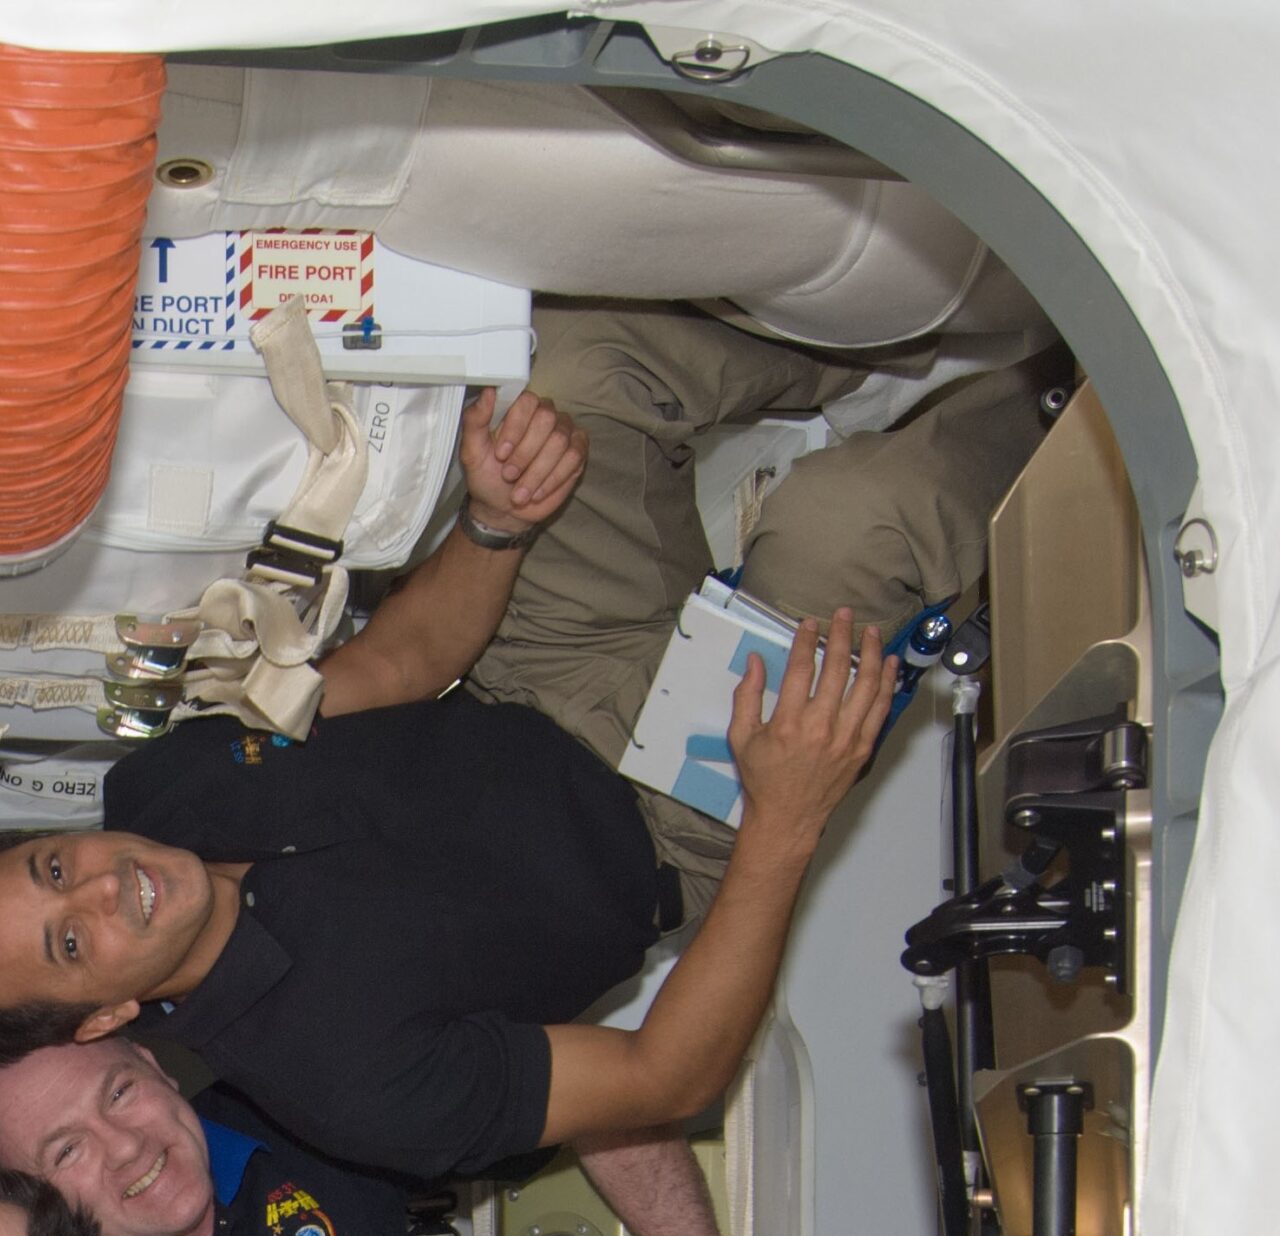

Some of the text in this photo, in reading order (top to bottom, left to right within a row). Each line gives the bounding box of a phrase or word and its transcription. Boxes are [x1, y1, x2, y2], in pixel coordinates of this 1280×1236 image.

[256, 239, 358, 251] EMERGENCY USE
[258, 265, 356, 281] FIRE PORT
[162, 296, 223, 313] PORT
[153, 318, 214, 335] DUCT
[368, 402, 391, 453] ZERO
[31, 780, 43, 792] G
[52, 781, 96, 796] ZERO
